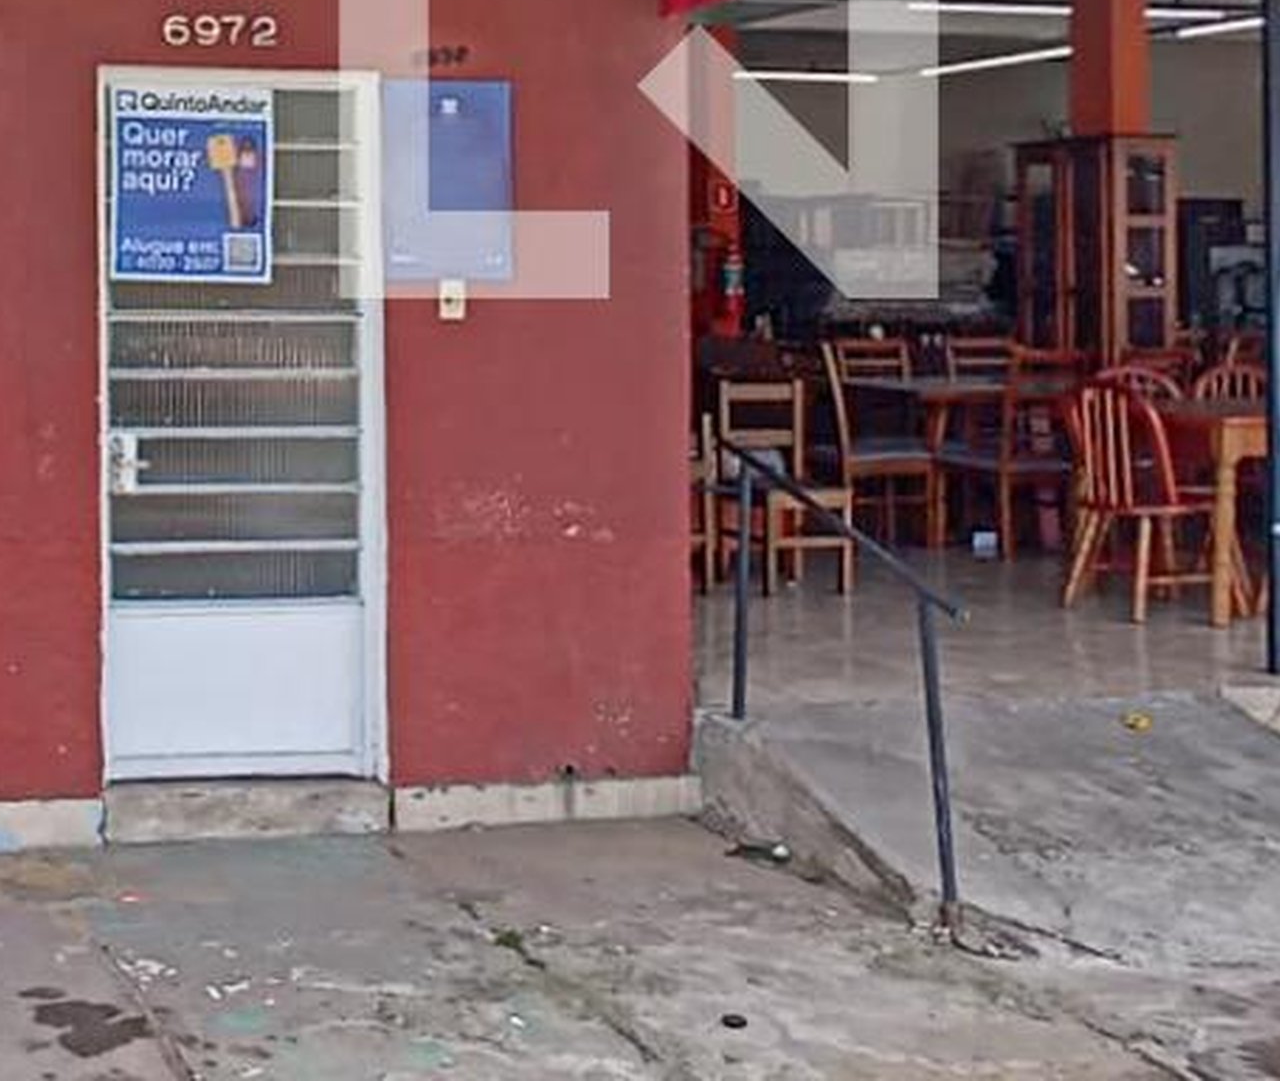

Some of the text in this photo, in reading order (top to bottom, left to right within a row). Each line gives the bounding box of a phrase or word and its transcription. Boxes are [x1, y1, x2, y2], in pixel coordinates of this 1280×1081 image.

[163, 15, 277, 46] 6972
[141, 91, 268, 113] QuintoAndar
[122, 122, 188, 145] Quer
[122, 149, 202, 168] morar
[122, 169, 195, 195] aqui?
